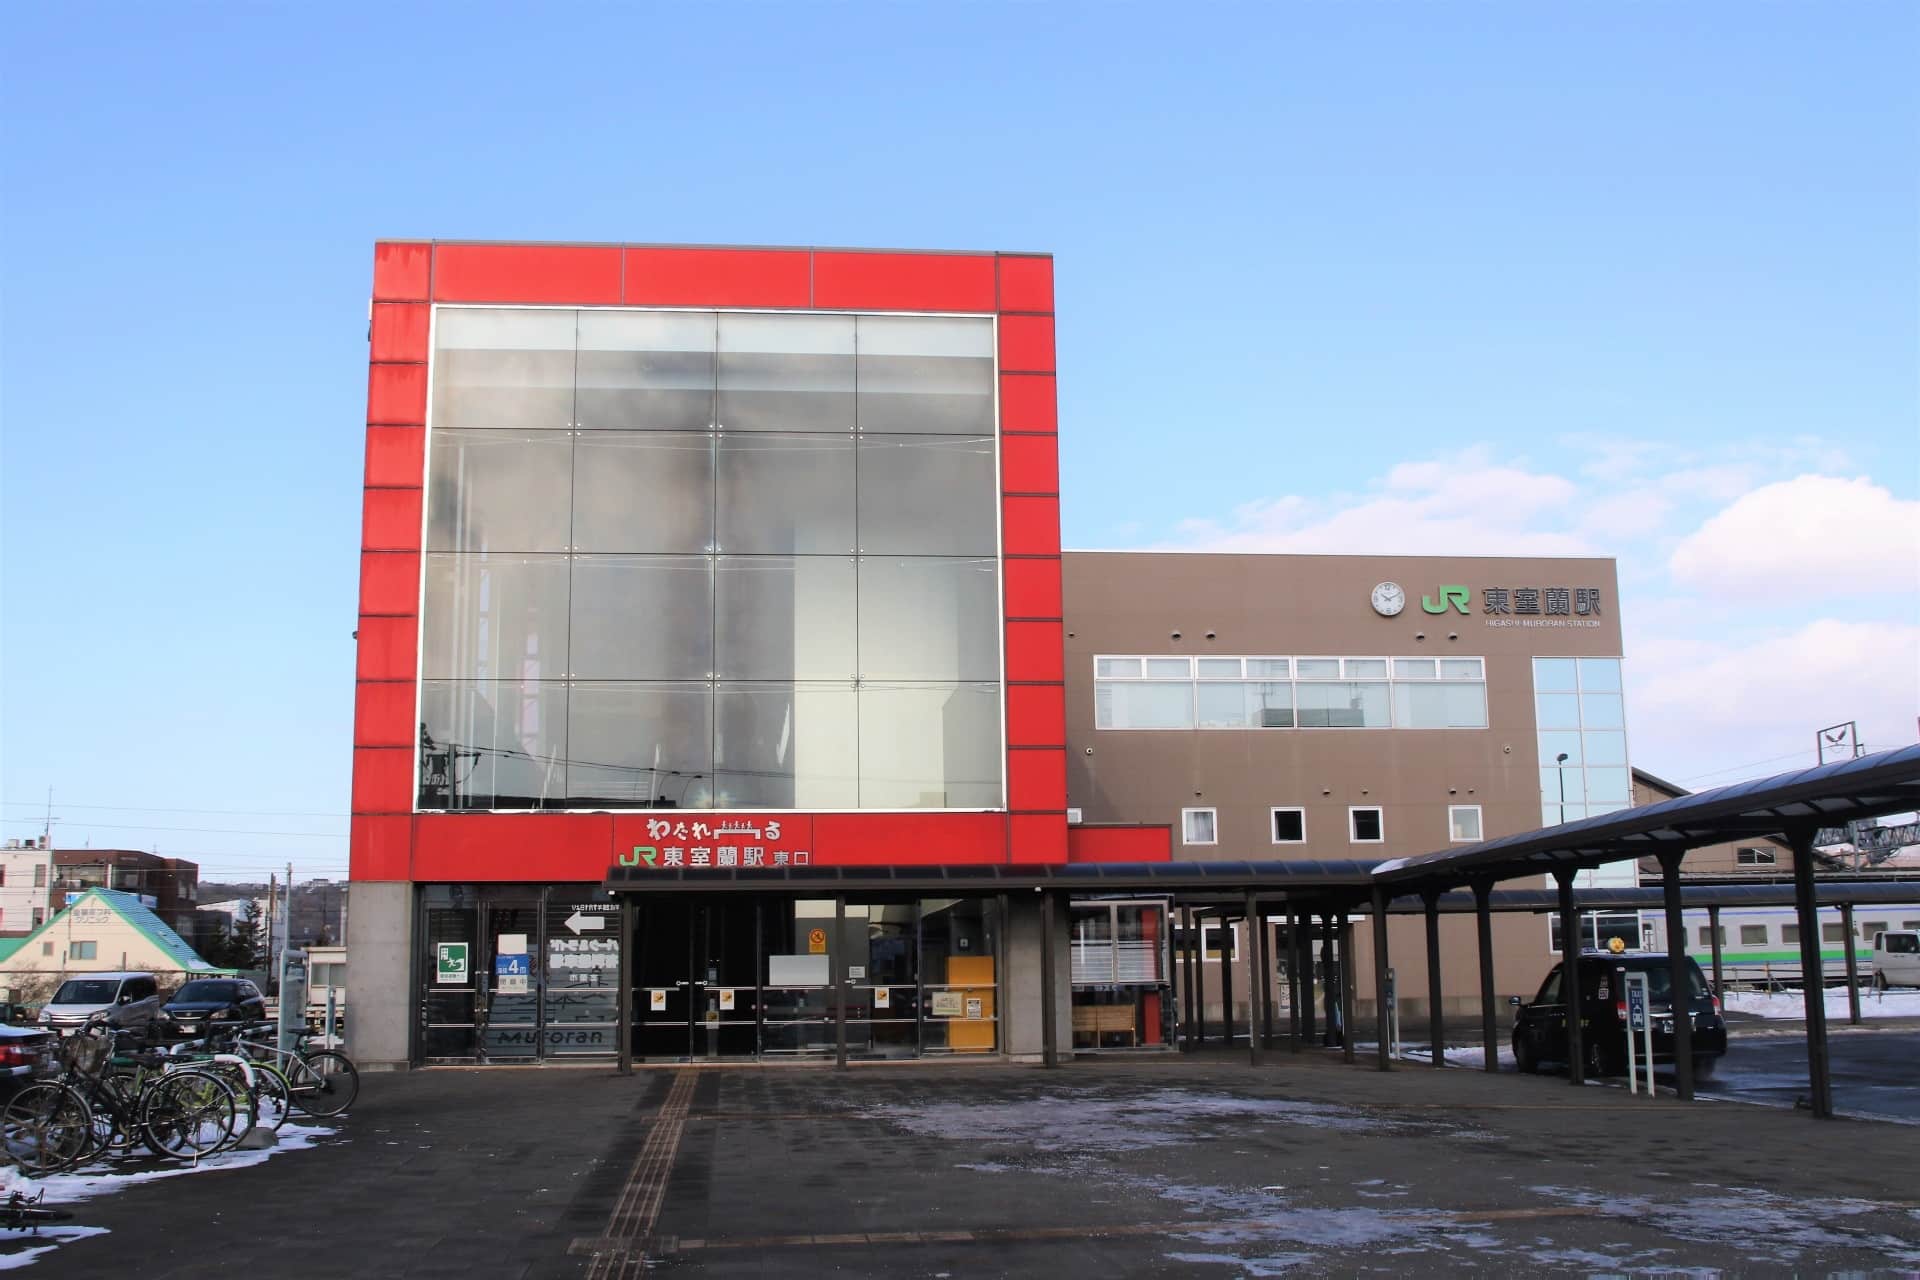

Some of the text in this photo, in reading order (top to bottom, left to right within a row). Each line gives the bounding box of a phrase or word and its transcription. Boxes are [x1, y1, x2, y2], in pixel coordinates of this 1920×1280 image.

[1421, 585, 1602, 616] JR 東室蘭駅
[1567, 619, 1601, 628] STATION
[618, 846, 810, 866] JR 東室蘭駅 東口
